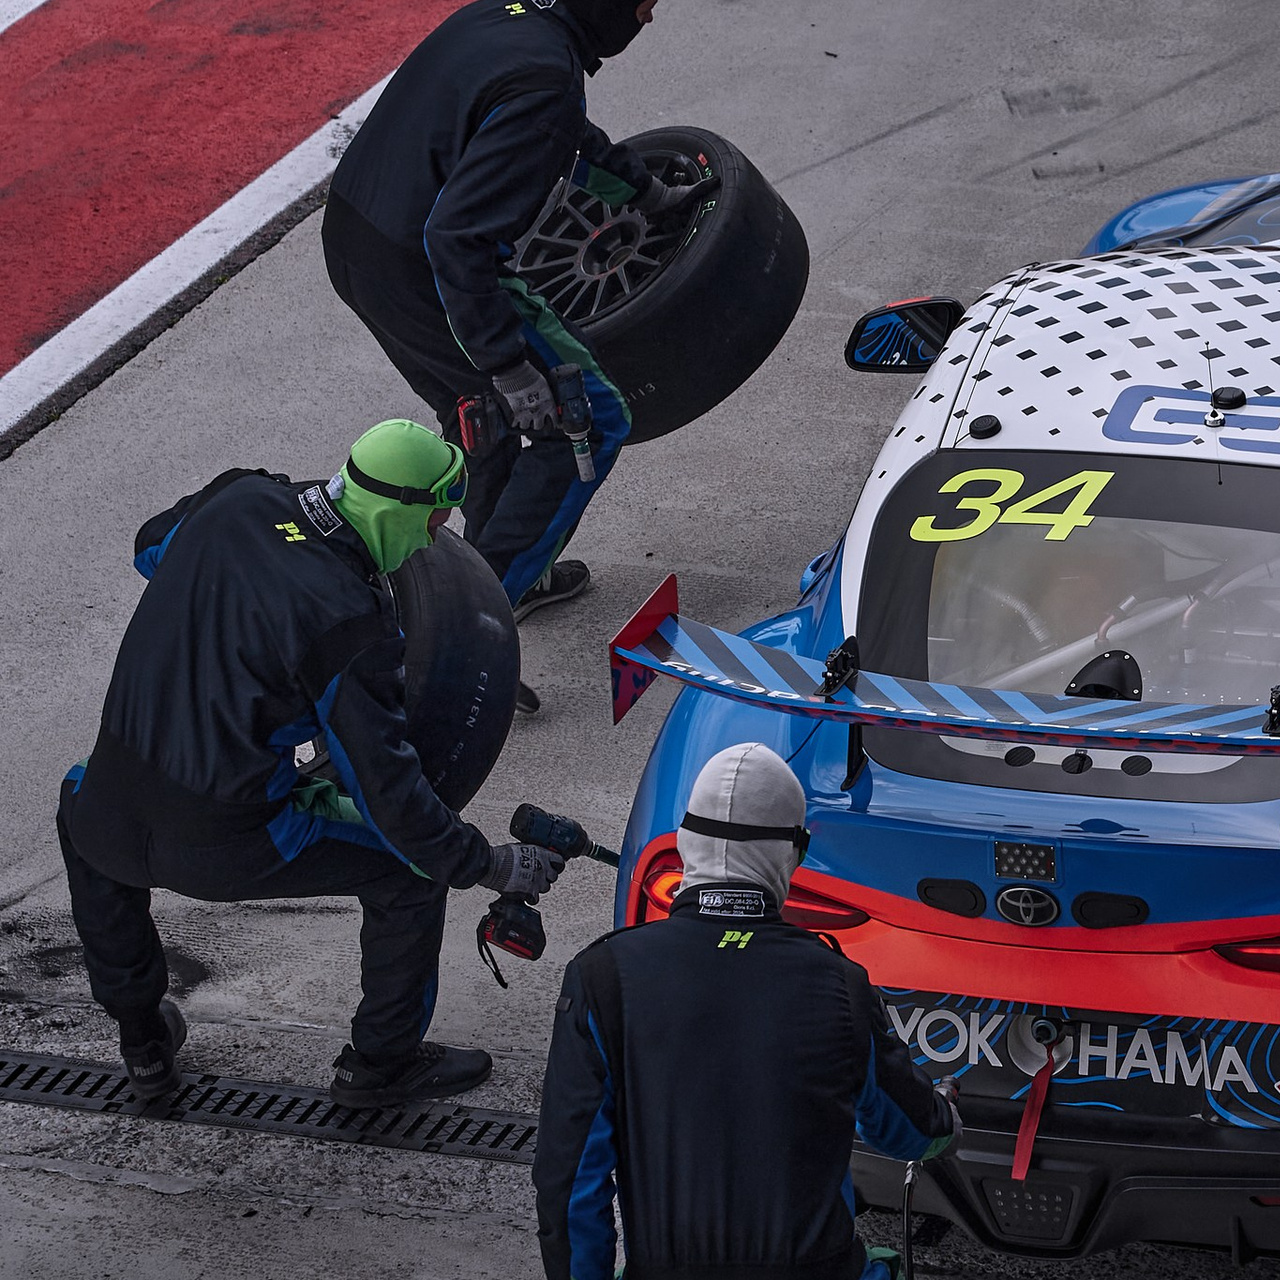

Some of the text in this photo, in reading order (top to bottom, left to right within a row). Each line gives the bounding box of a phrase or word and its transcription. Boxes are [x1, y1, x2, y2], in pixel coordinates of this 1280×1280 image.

[909, 468, 1116, 543] 34
[274, 521, 308, 543] P1
[465, 671, 489, 728] N3113
[703, 895, 723, 906] FIA
[717, 930, 755, 949] P1
[886, 1005, 1259, 1094] YOKOHAMA
